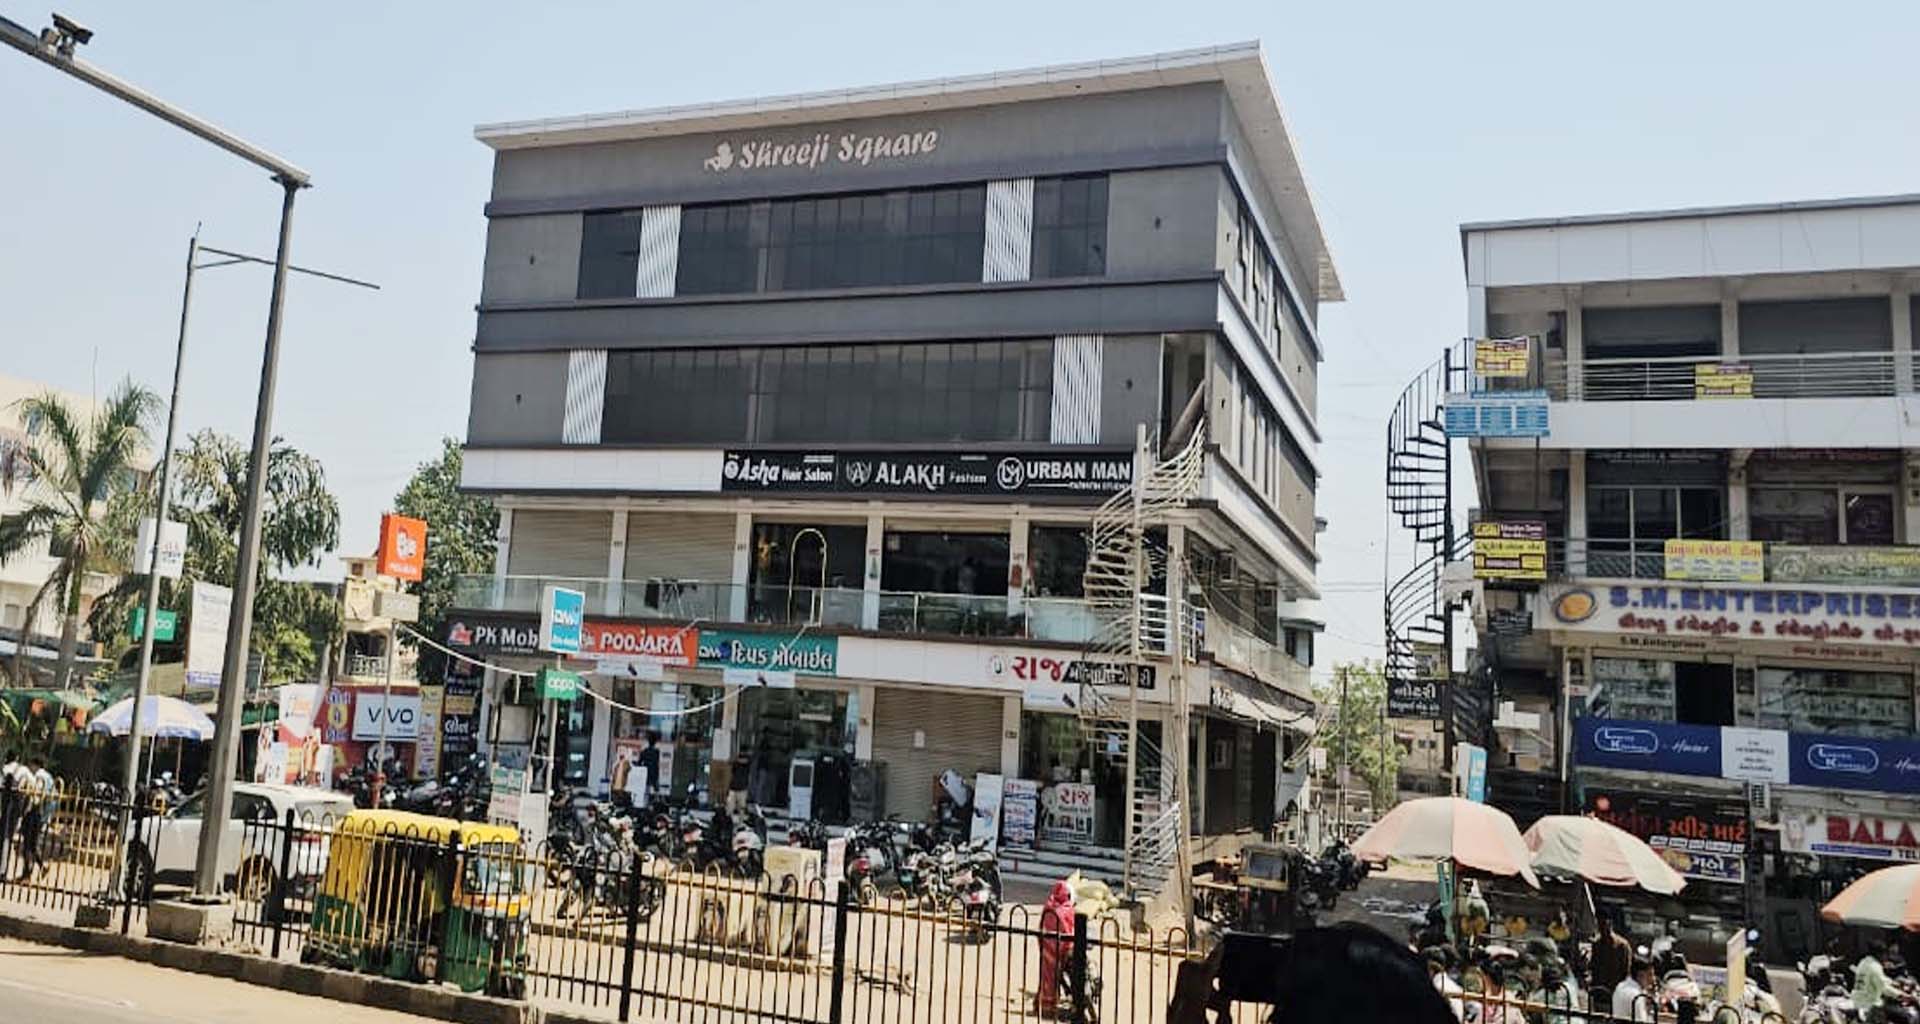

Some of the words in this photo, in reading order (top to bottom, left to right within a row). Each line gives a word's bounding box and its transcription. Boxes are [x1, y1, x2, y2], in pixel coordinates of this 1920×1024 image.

[739, 133, 830, 170] Shreeji
[837, 130, 938, 166] Square
[738, 458, 780, 486] Asha
[804, 467, 833, 482] Salon
[875, 461, 945, 491] ALAKH
[1026, 461, 1086, 481] URBAN
[1091, 462, 1131, 480] MAN
[475, 625, 496, 644] PK
[500, 627, 540, 649] Mob
[1012, 655, 1064, 682] રાજ
